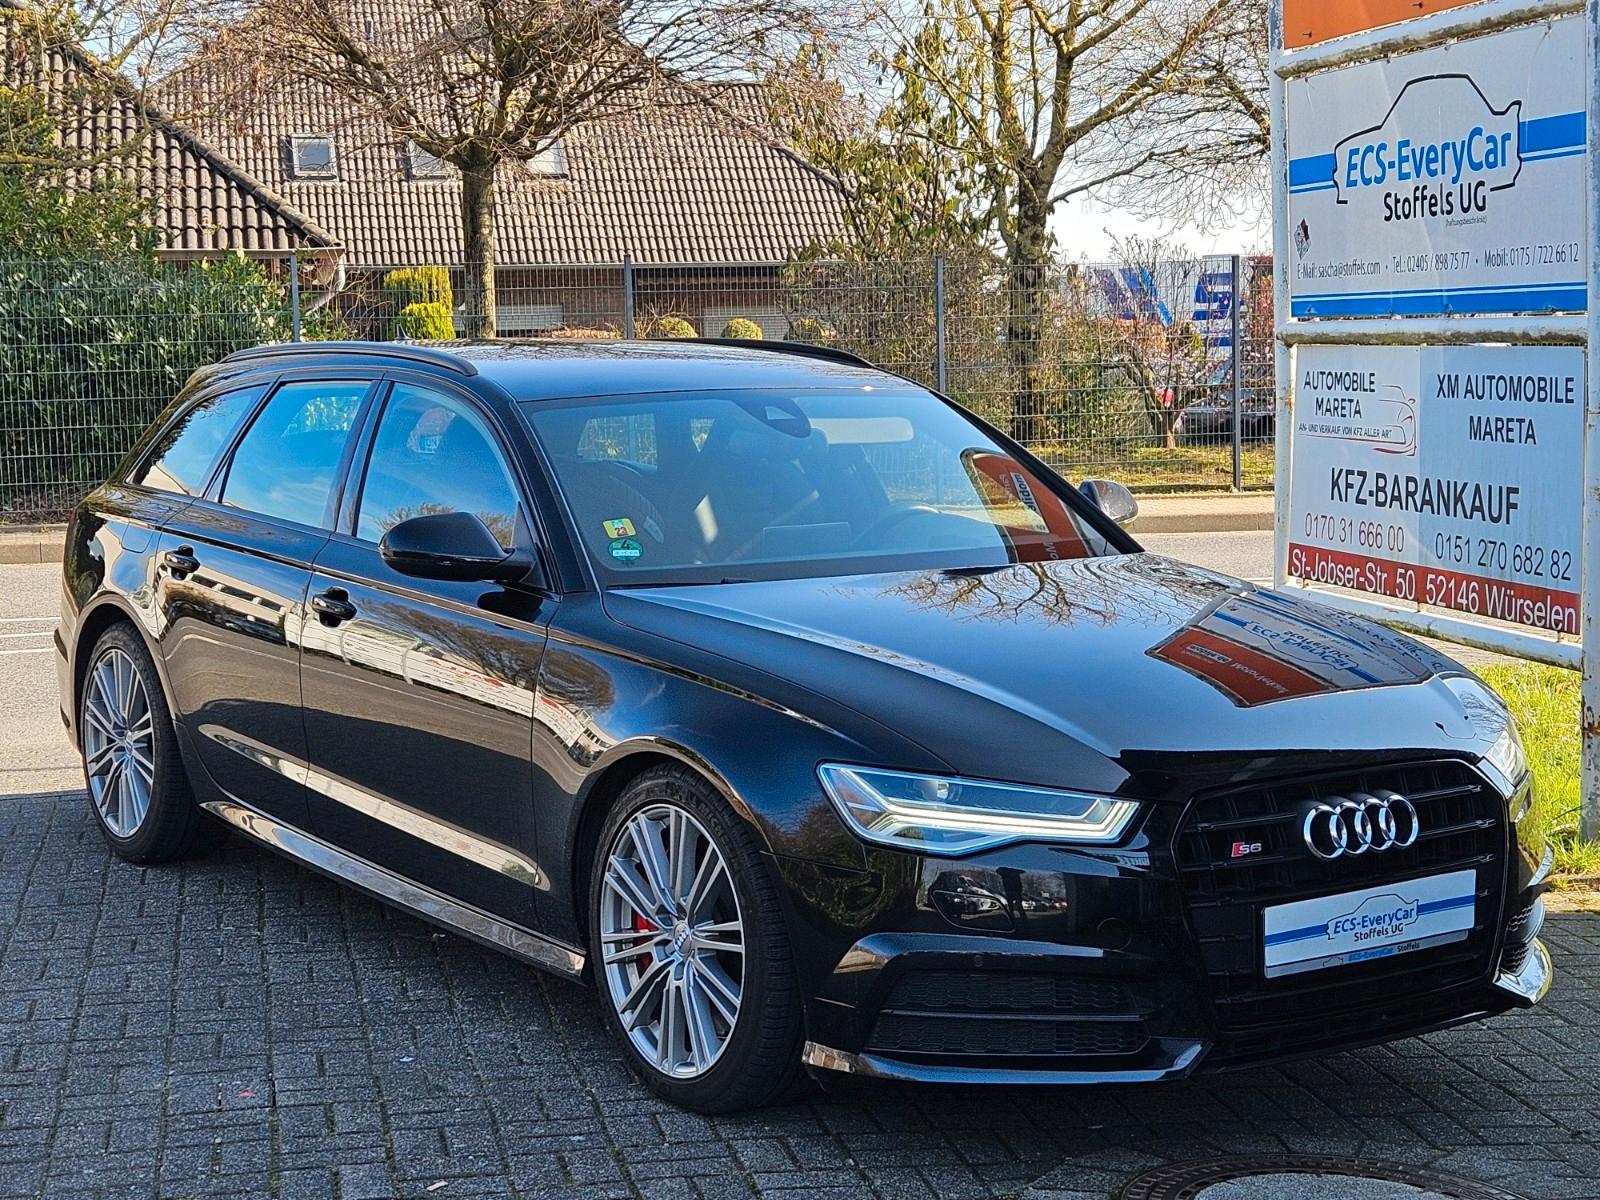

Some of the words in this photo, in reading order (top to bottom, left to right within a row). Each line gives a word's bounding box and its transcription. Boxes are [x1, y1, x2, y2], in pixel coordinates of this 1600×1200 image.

[1346, 126, 1512, 188] ECS-EveryCar
[1383, 183, 1454, 222] Stoffels
[1459, 180, 1487, 214] UG
[1297, 263, 1316, 279] E-Mail:
[1318, 258, 1381, 279] sascha@stoffels.com
[1393, 256, 1406, 273] Tel.:
[1406, 254, 1429, 272] 02405
[1435, 253, 1448, 271] 898
[1450, 252, 1459, 270] 75
[1460, 251, 1470, 269] 77
[1484, 247, 1509, 267] Mobil:
[1510, 246, 1530, 266] 0175
[1538, 245, 1553, 264] 722
[1555, 244, 1566, 263] 66
[1569, 242, 1579, 262] 12
[1303, 371, 1376, 393] AUTOMOBILE
[1436, 373, 1459, 399] XM
[1464, 374, 1575, 404] AUTOMOBILE
[1315, 397, 1362, 419] MARETA
[1308, 423, 1320, 432] UND
[1319, 424, 1341, 434] VERKAUF
[1341, 426, 1353, 435] VON
[1353, 427, 1363, 437] KFZ
[1364, 428, 1380, 438] ALLER
[1381, 430, 1393, 438] ART
[1469, 415, 1537, 445] MARETA
[1330, 467, 1520, 525] KFZ-BARANKAUF
[621, 540, 630, 550] 4
[1305, 512, 1335, 541] 0170
[1339, 518, 1353, 544] 31
[1358, 521, 1383, 549] 666
[1387, 525, 1405, 552] 00
[1435, 532, 1470, 563] 0151
[1478, 538, 1507, 571] 270
[1513, 544, 1544, 577] 682
[1550, 549, 1572, 581] 82
[1291, 549, 1390, 595] St-Jobser-Str.
[1395, 568, 1416, 600] 50
[1426, 573, 1480, 613] 52146
[1485, 583, 1576, 634] Würselen
[1238, 842, 1263, 854] S6
[1333, 908, 1415, 935] ECS-EveryCar
[1354, 927, 1389, 942] Stoffels
[1391, 923, 1404, 934] UG
[1348, 947, 1394, 962] ECS-EveryCar
[1397, 942, 1420, 953] Stoffels
